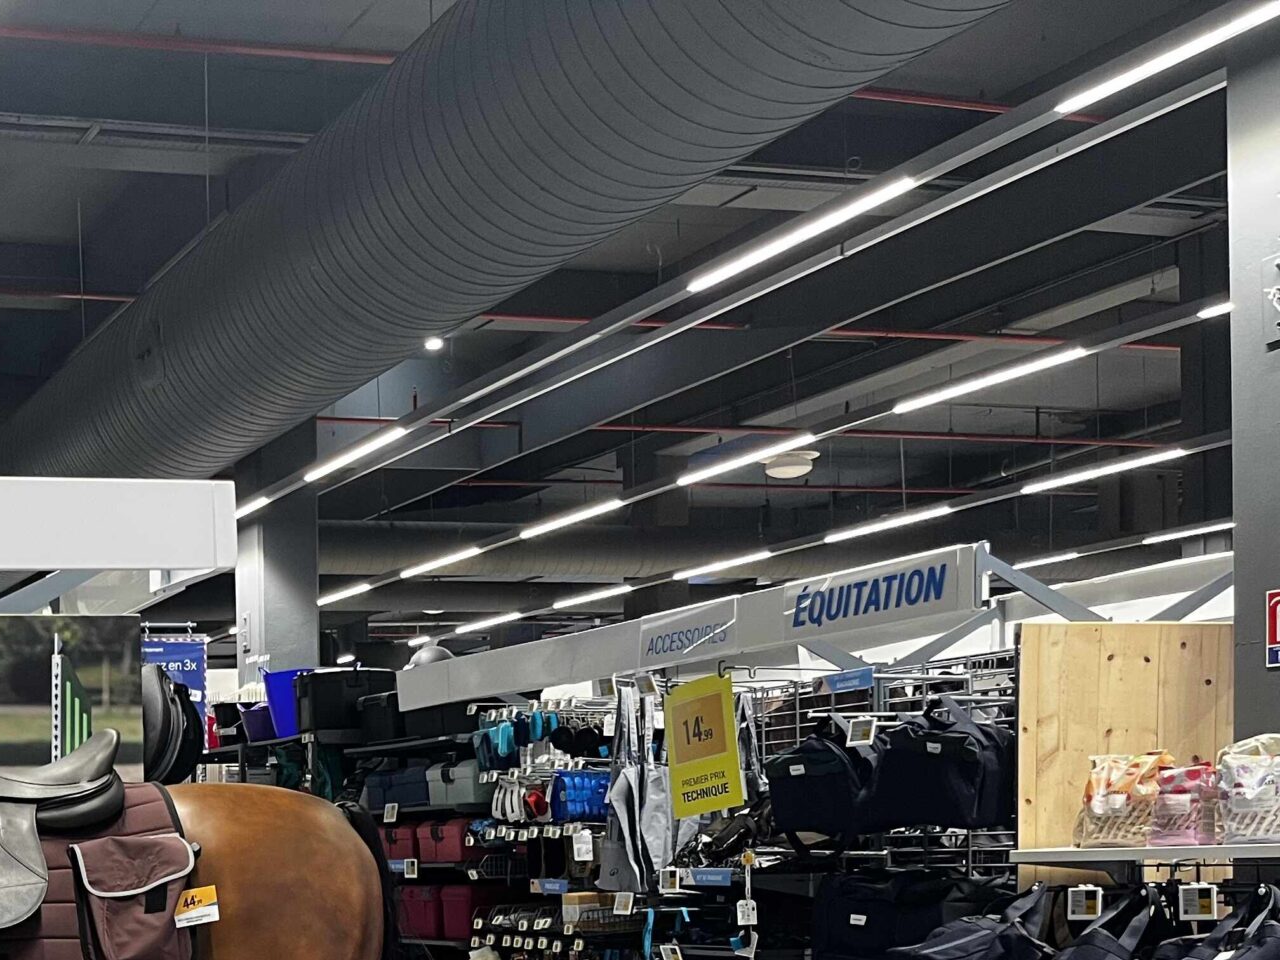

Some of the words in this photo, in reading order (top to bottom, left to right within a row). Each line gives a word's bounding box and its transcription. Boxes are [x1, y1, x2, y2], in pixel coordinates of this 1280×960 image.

[792, 563, 947, 628] ÉQUITATION
[646, 621, 728, 657] ACCESSOIRES
[167, 662, 182, 671] en
[183, 659, 197, 671] 3x
[681, 773, 709, 787] PREMIER
[709, 770, 726, 782] PRIX
[681, 782, 730, 803] TECHNIQUE
